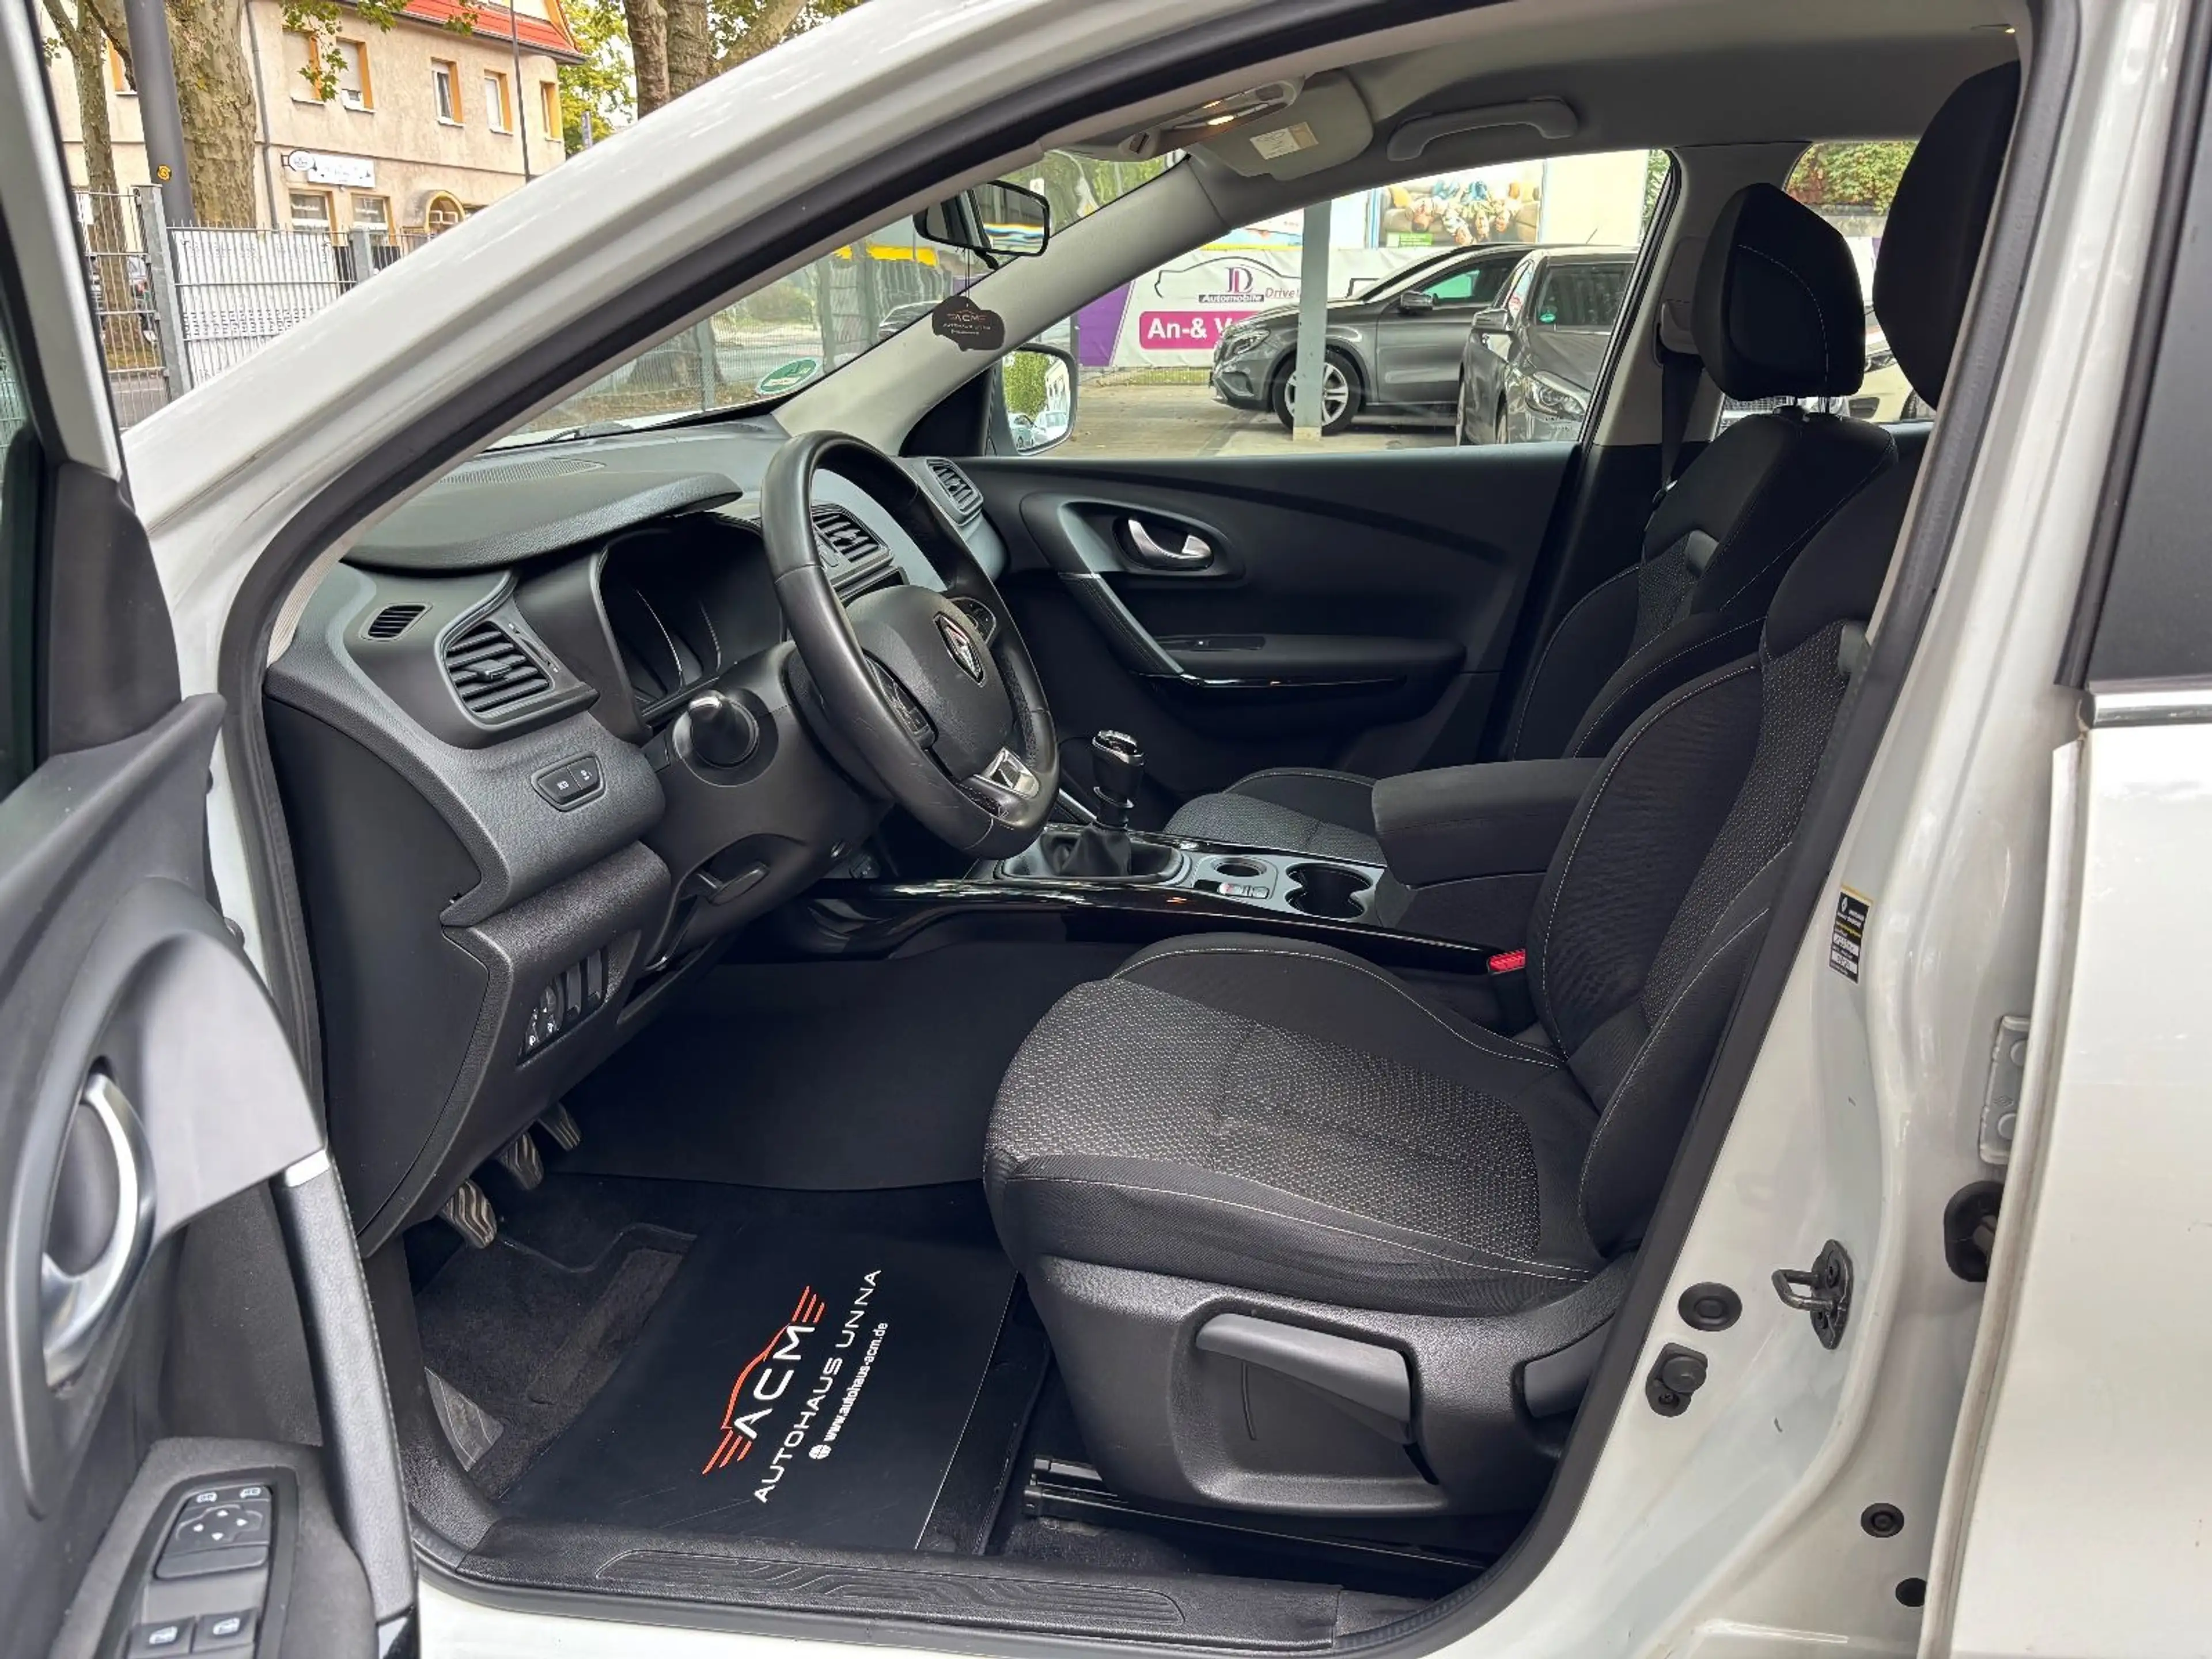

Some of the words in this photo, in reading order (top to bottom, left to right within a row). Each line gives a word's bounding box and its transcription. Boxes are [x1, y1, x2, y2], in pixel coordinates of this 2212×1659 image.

[734, 1326, 815, 1440] ACM
[754, 1357, 843, 1503] AUTOHAUS
[835, 1270, 881, 1348] UNNA
[823, 1322, 888, 1442] www.autohaus-acm.de
